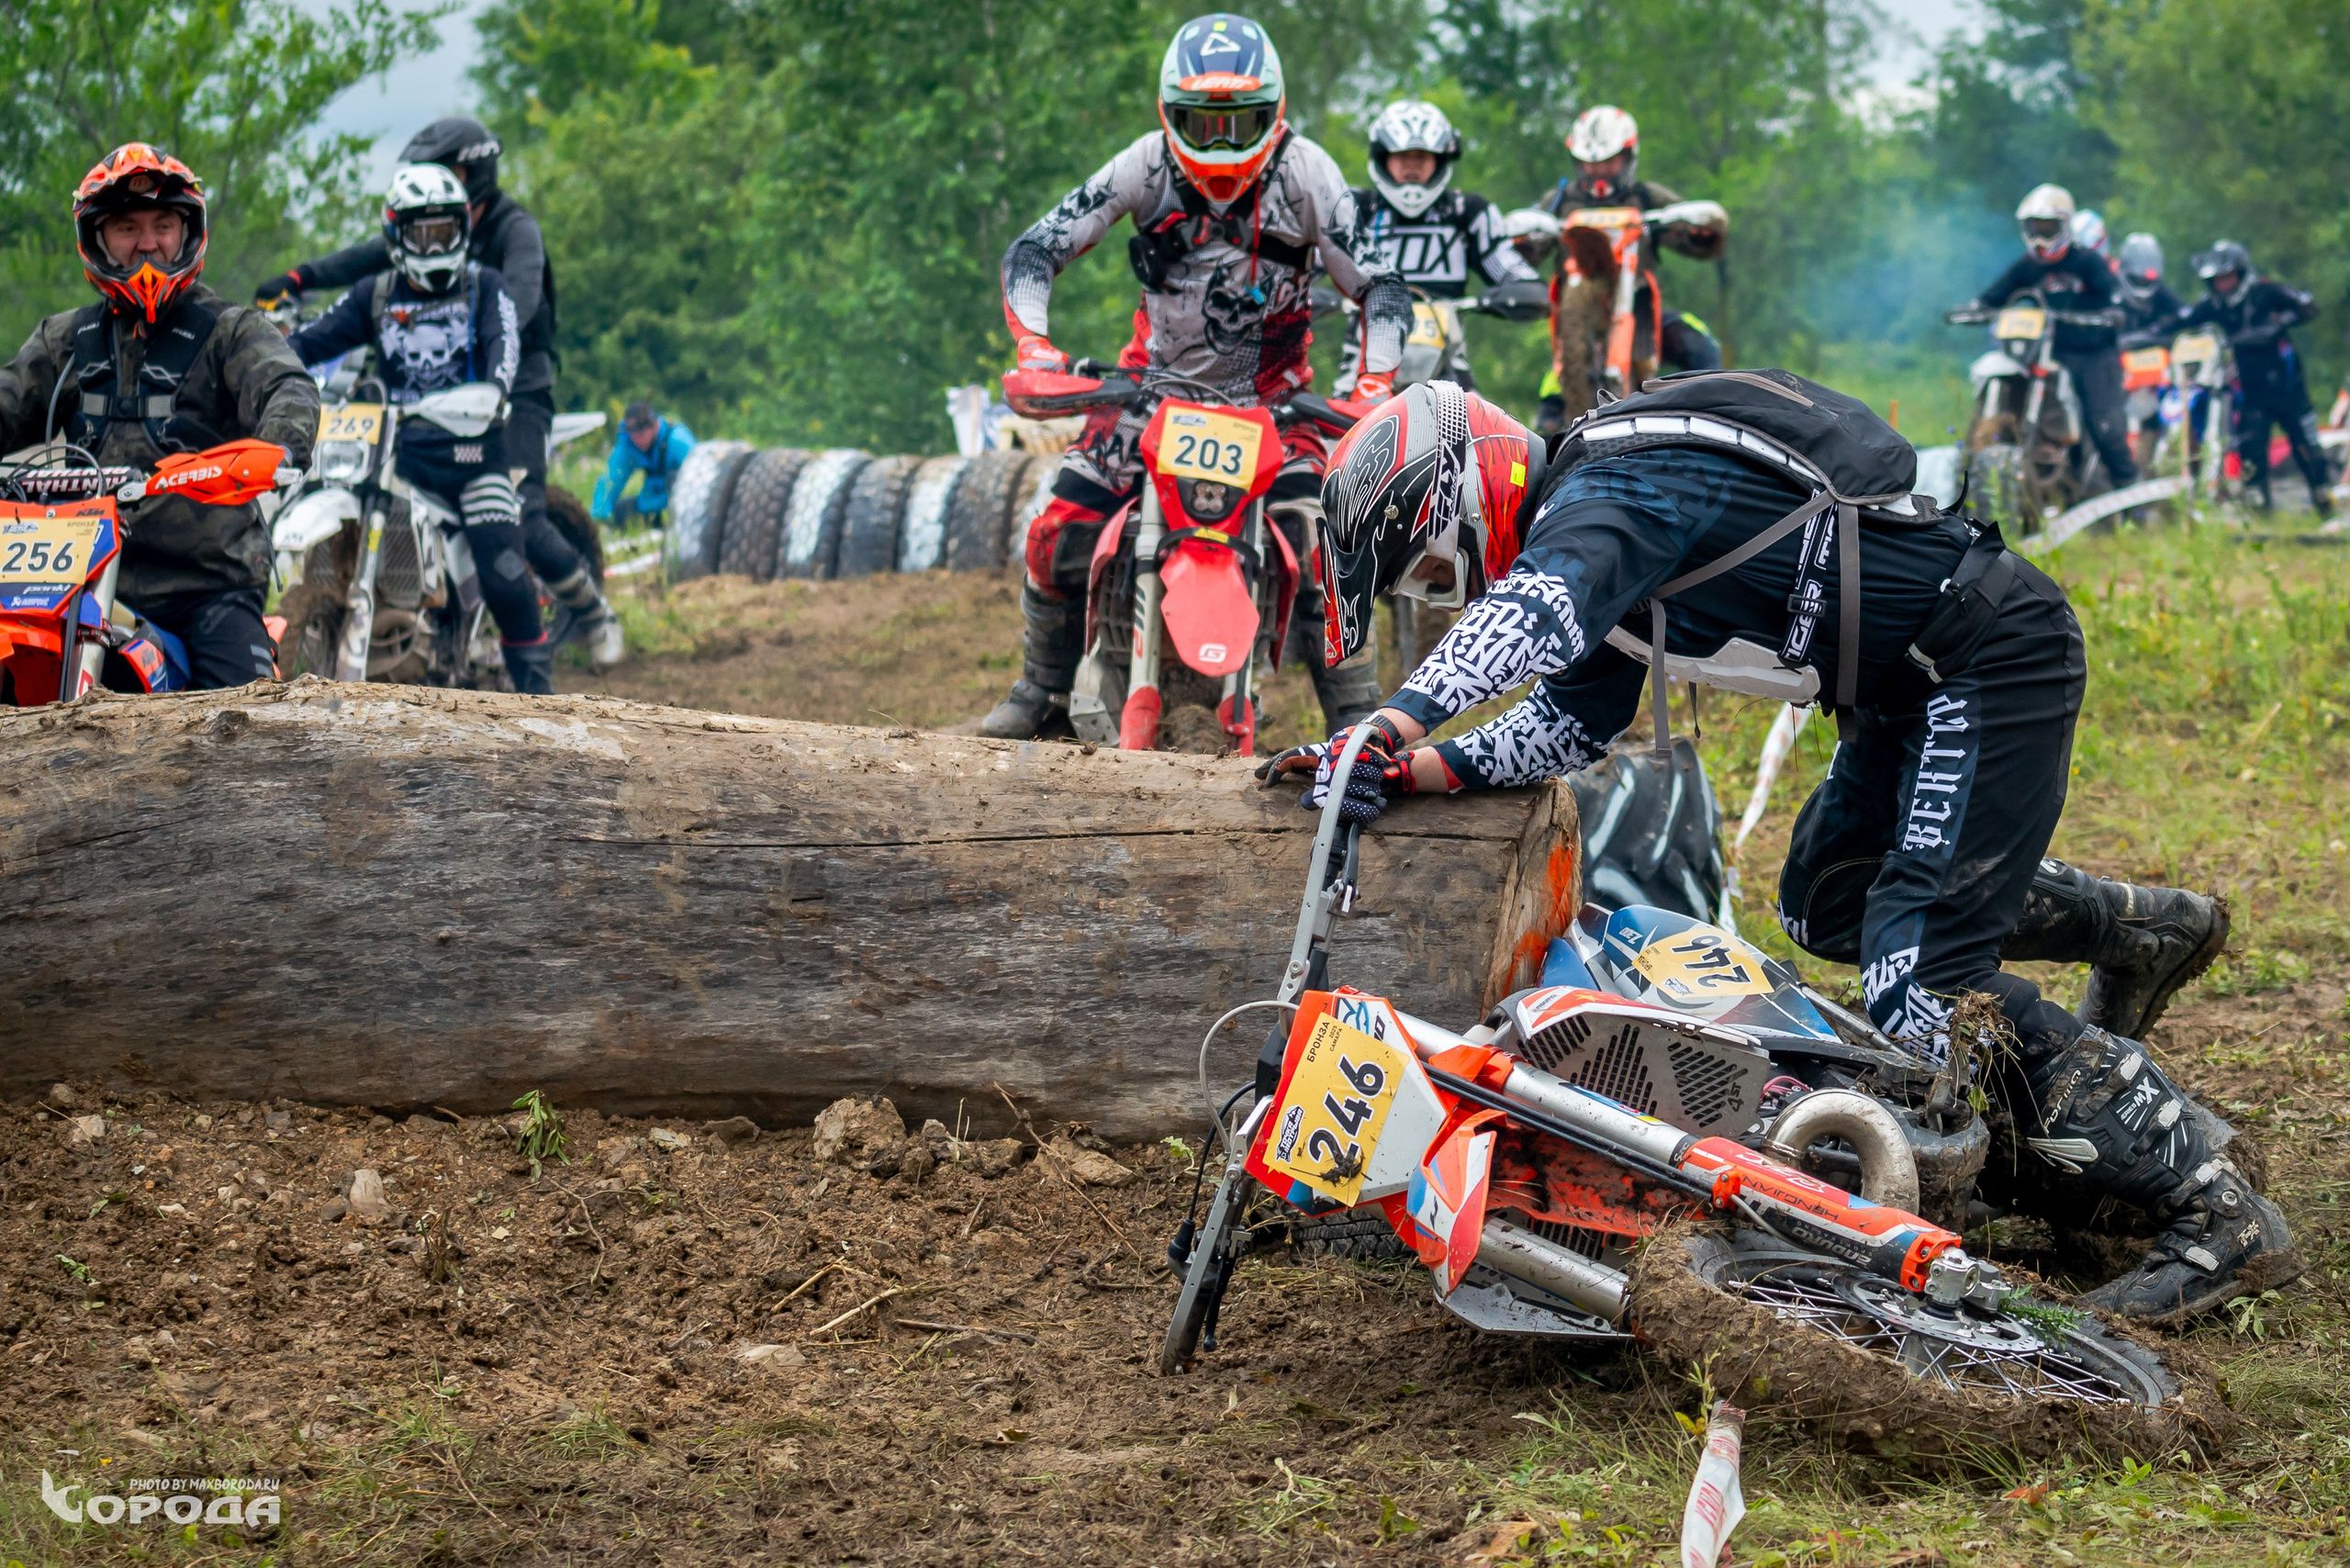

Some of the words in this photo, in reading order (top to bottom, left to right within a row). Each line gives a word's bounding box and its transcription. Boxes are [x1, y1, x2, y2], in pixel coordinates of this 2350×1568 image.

[328, 417, 375, 435] 269
[1172, 434, 1243, 476] 203
[154, 465, 222, 489] ACERBIS
[76, 509, 105, 517] KTM
[2, 543, 73, 573] 256
[1671, 935, 1751, 989] 246
[1306, 1021, 1330, 1063] БРОНЗА
[1329, 1025, 1337, 1039] 2025
[1329, 1027, 1343, 1052] САМАРА
[2133, 1076, 2161, 1107] MX
[1307, 1054, 1385, 1168] 246
[1281, 1119, 1293, 1148] ТОЧКА
[1792, 1226, 1873, 1265] ENDURO
